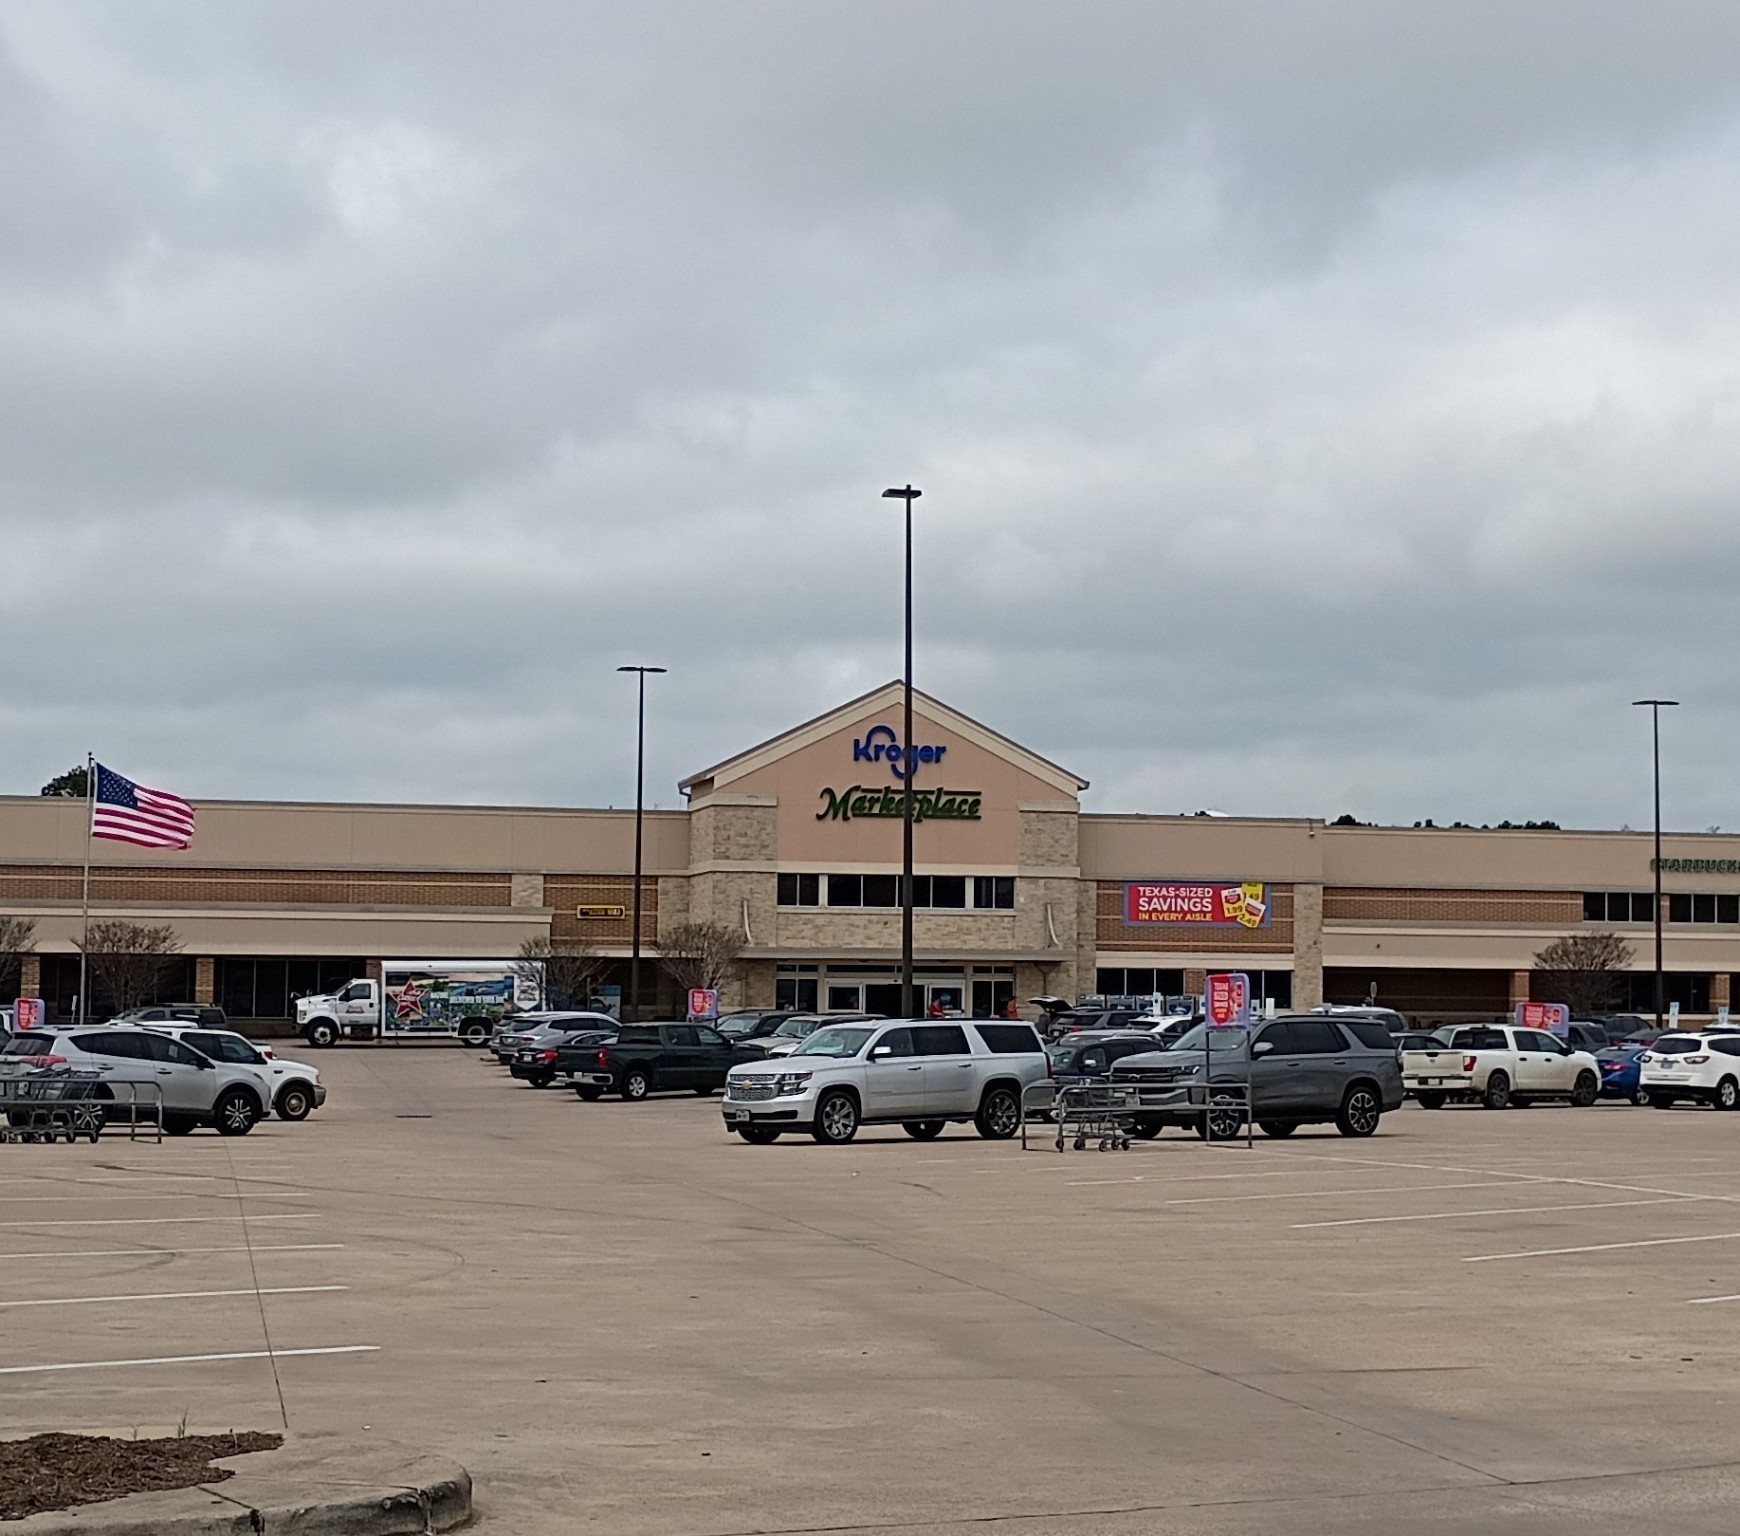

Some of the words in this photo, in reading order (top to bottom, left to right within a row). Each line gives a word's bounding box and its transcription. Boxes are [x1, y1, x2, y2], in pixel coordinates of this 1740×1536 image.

[853, 725, 947, 780] Kroger
[816, 785, 982, 823] Markeplace
[1650, 858, 1740, 873] STARBUCK
[1138, 887, 1213, 897] TEXAS-SIZED
[1138, 898, 1212, 912] SAVINGS
[1151, 912, 1183, 921] EVERY
[1185, 913, 1213, 921] AISLE
